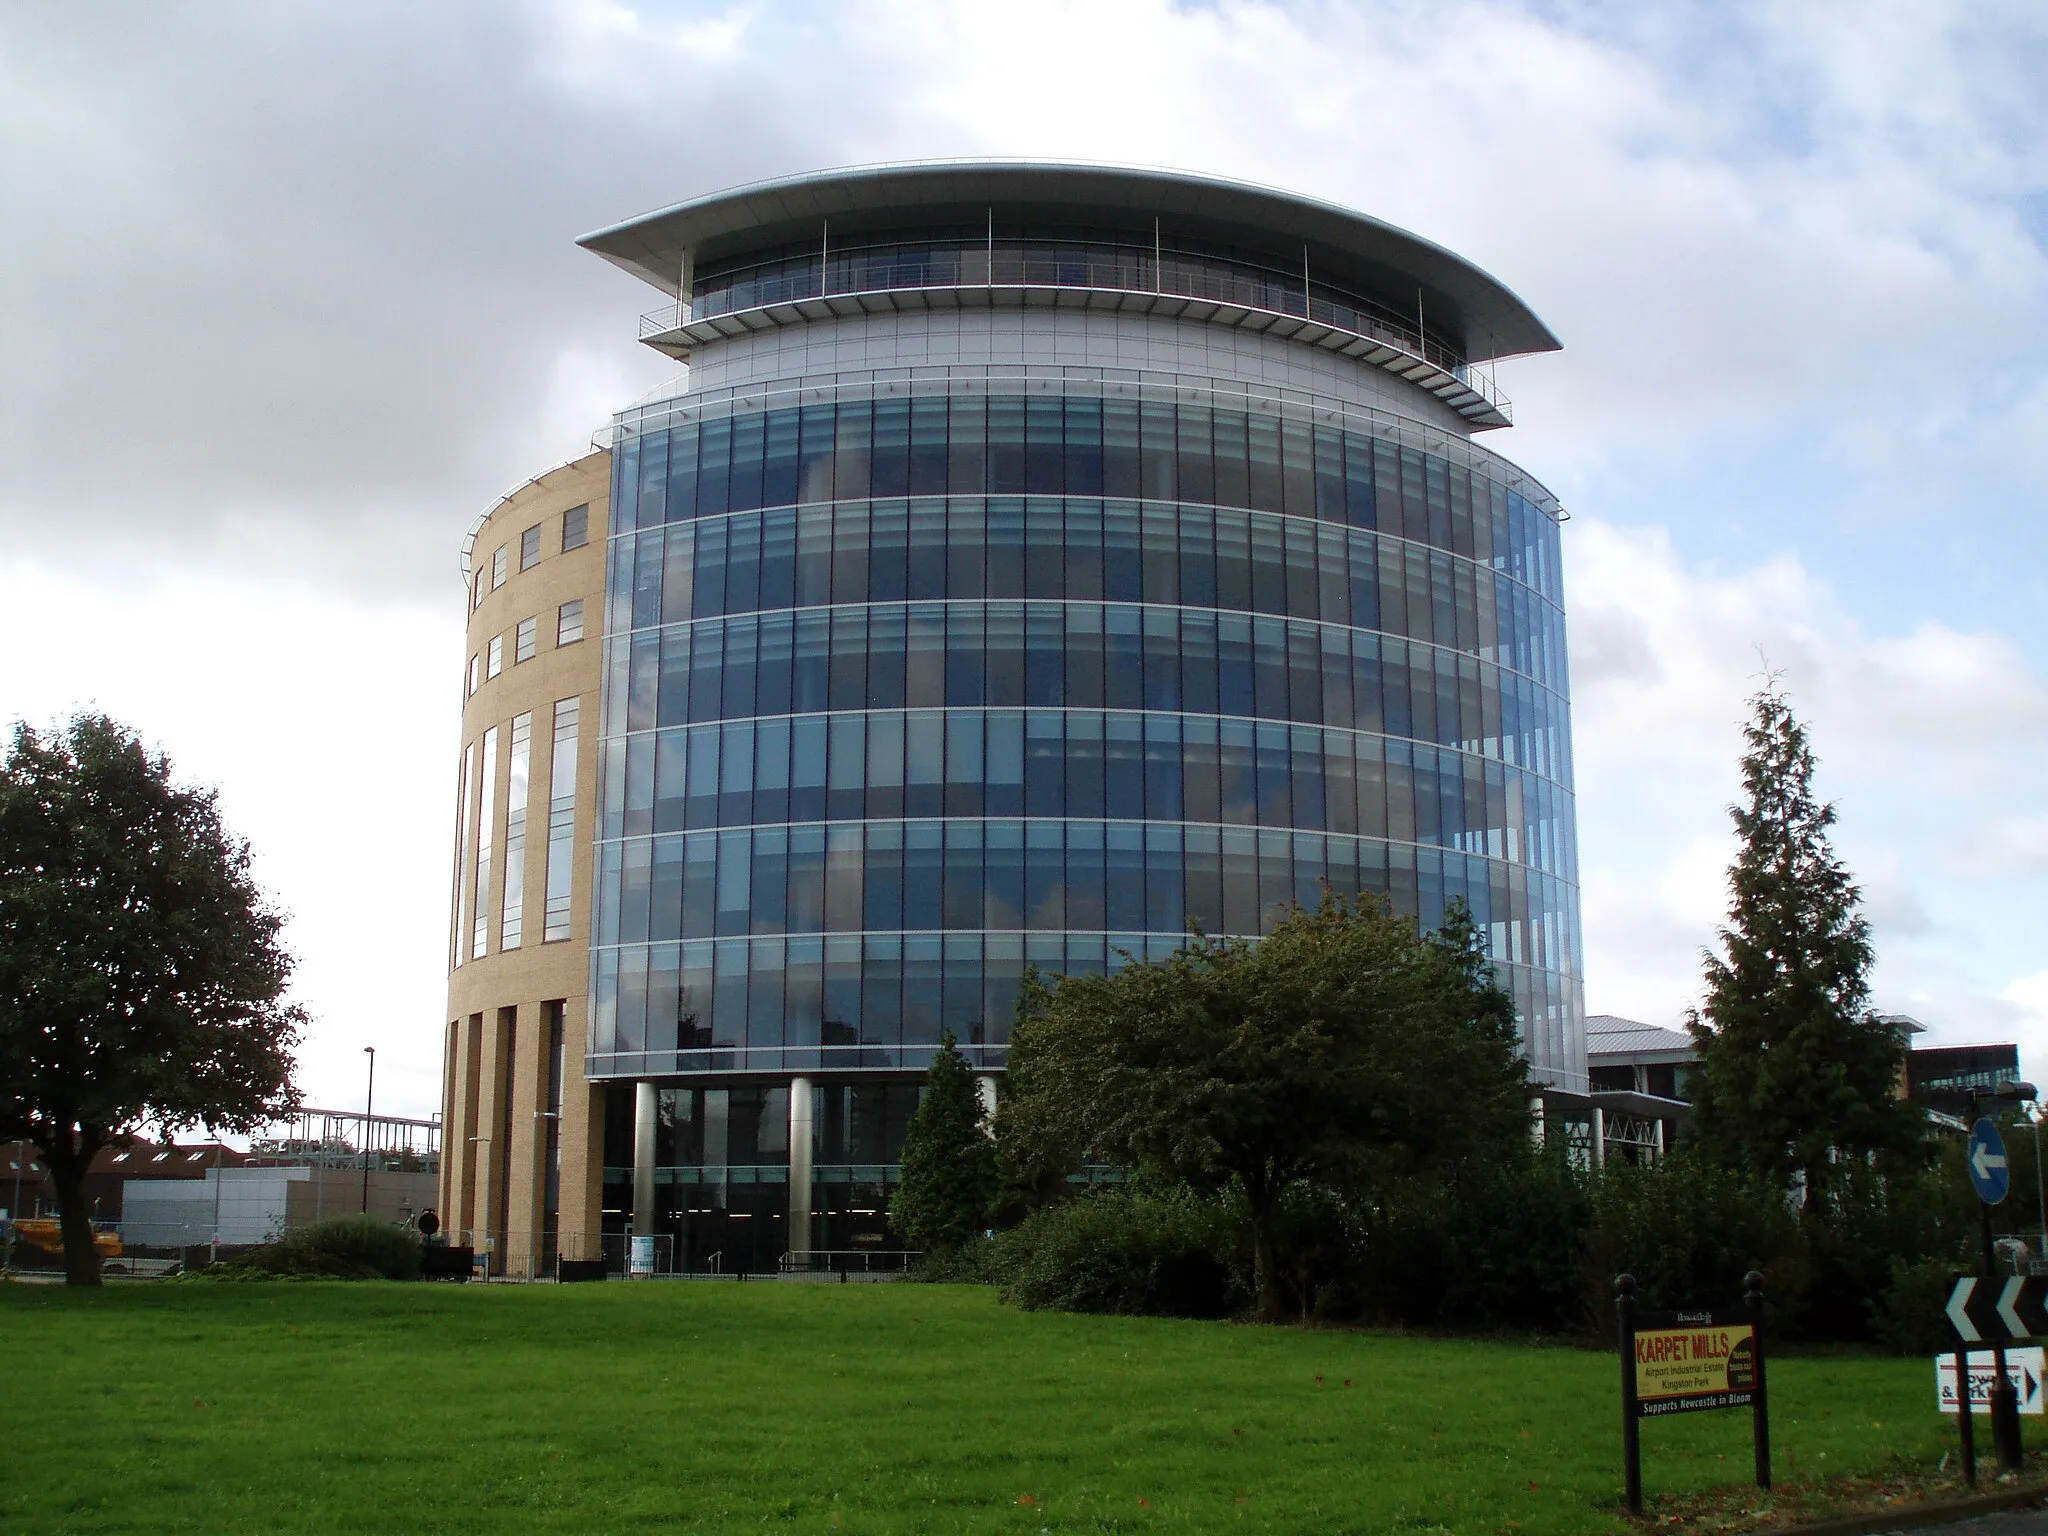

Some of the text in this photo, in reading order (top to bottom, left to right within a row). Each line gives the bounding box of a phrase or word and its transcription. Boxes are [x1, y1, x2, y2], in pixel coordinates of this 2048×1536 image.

[1636, 1333, 1729, 1363] KARPET MILLS
[1645, 1367, 1669, 1378] Airport
[1671, 1364, 1702, 1375] Industrial
[1704, 1362, 1725, 1373] Estate
[1662, 1376, 1710, 1390] Kingston Park
[1942, 1386, 1953, 1398] &
[1643, 1393, 1751, 1414] Supports Newcastle in Bloom
